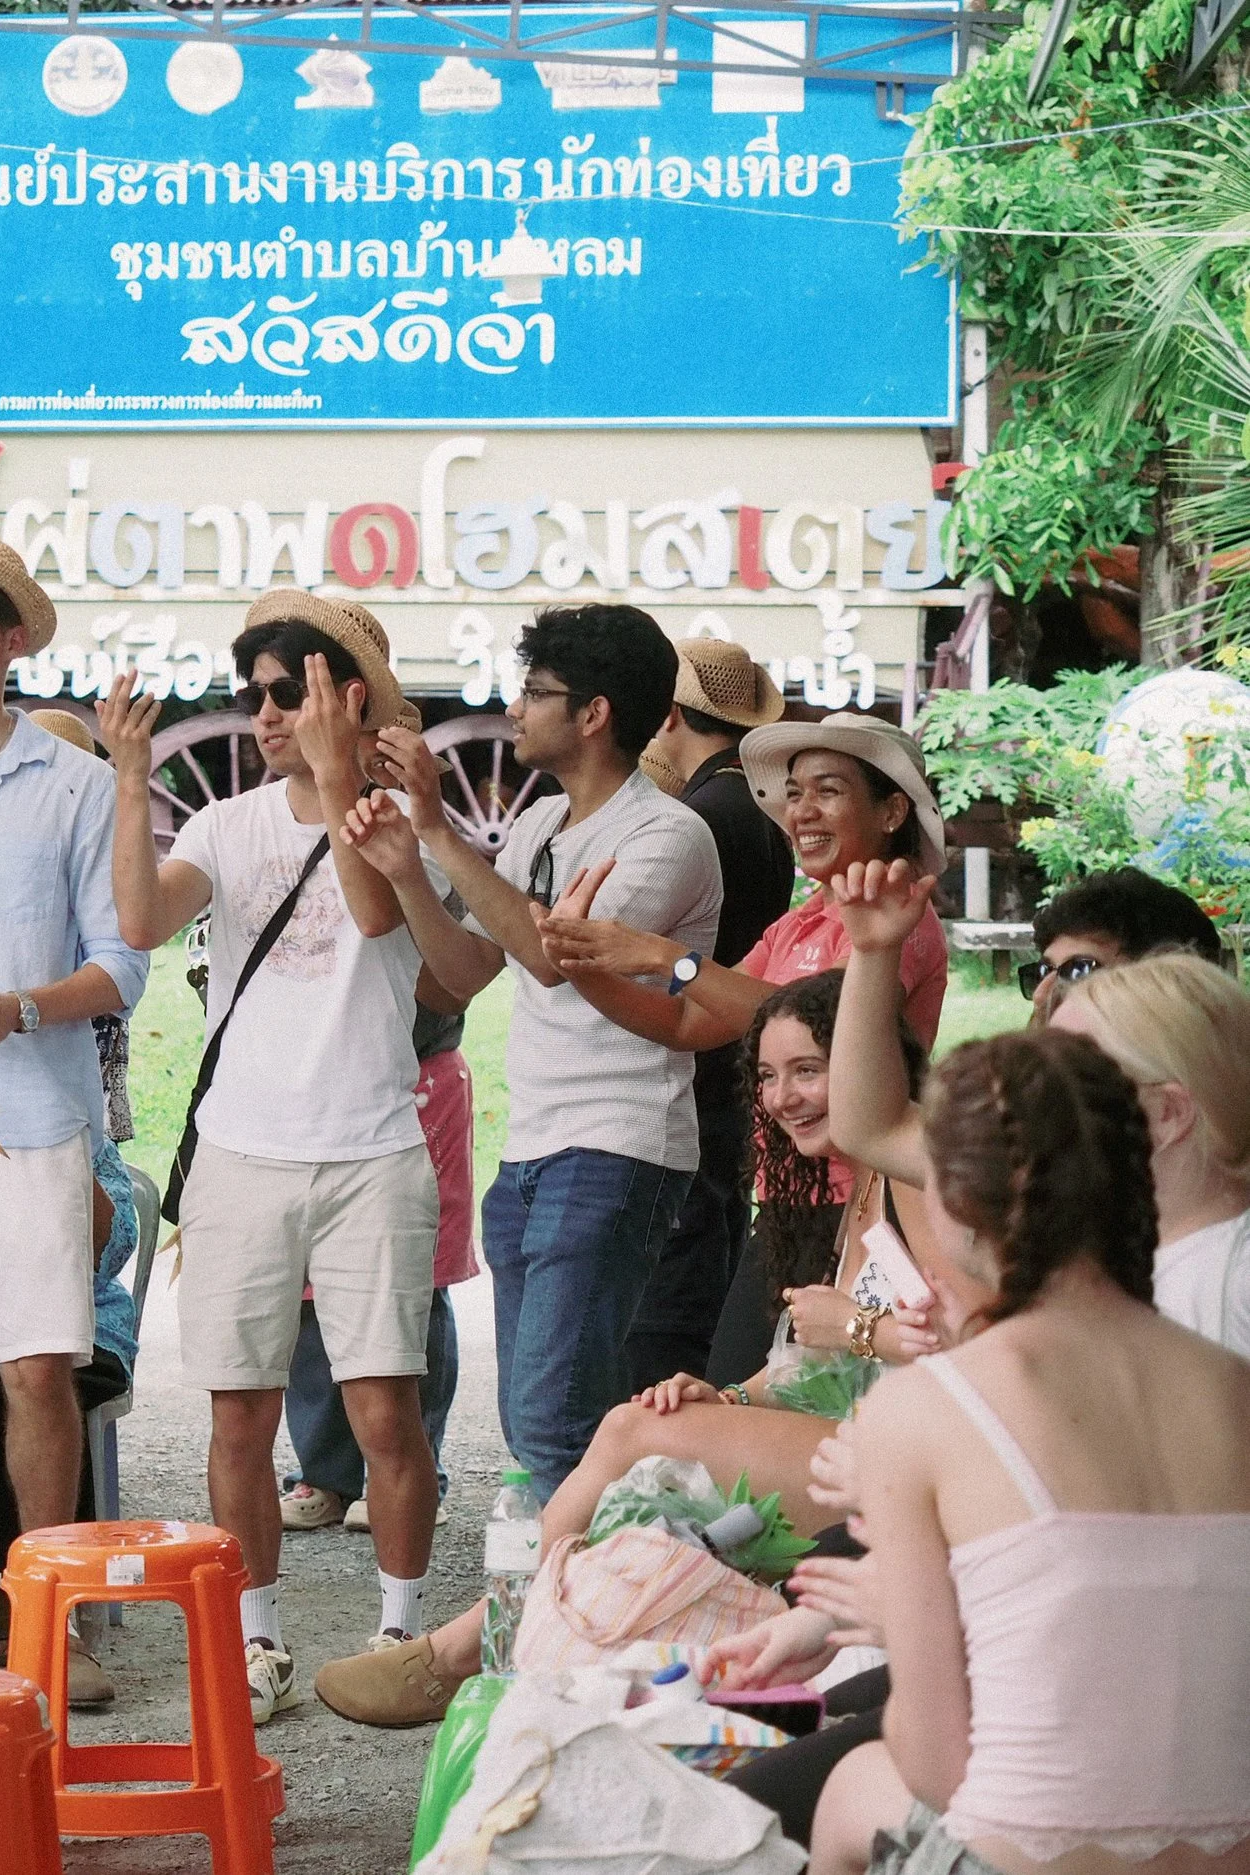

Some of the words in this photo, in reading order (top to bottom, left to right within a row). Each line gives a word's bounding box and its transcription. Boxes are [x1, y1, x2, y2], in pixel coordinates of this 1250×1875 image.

[110, 220, 642, 302] ชุมชนตำบลบ้านหลม
[181, 292, 555, 377] สวัสดีจ้า
